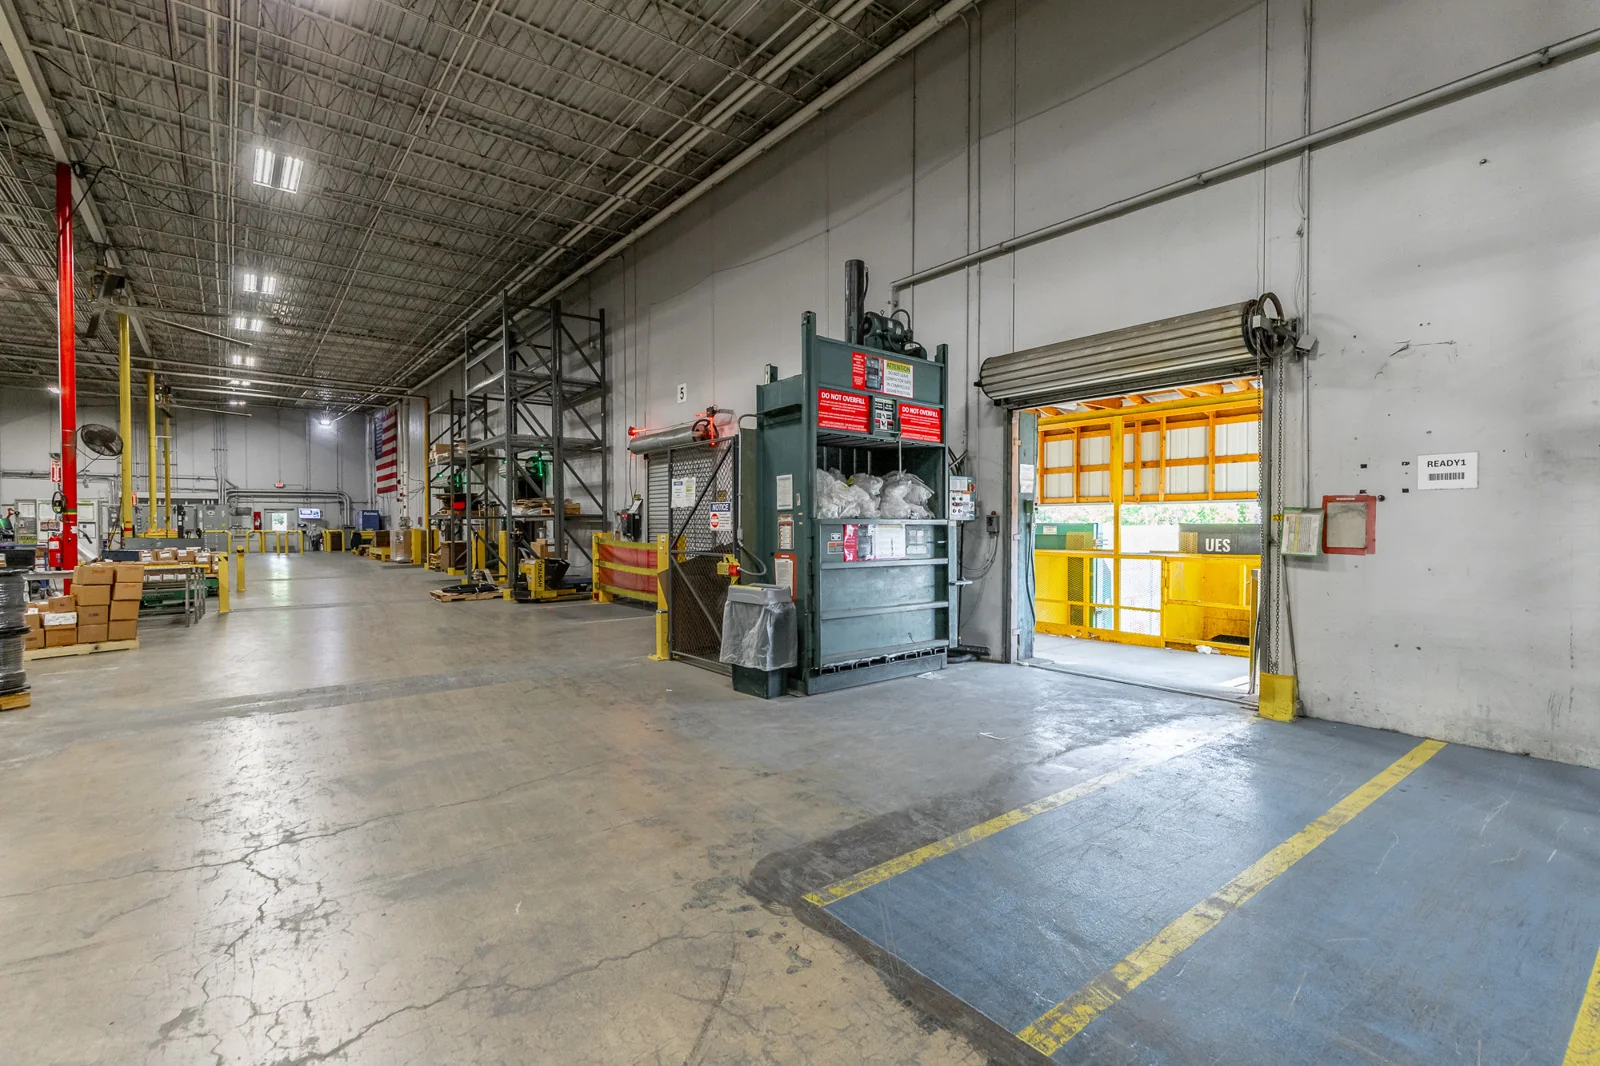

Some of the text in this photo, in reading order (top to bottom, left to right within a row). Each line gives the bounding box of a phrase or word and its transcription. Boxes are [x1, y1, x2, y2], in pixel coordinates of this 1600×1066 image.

[886, 362, 911, 373] ATTENTION
[680, 386, 684, 400] 5
[831, 393, 842, 401] NOT
[843, 395, 866, 405] OVERFILL
[910, 407, 919, 415] NOT
[920, 409, 938, 418] OVERFILL
[1427, 459, 1466, 468] READY1
[712, 503, 729, 511] NOTICE
[1205, 538, 1231, 552] UES
